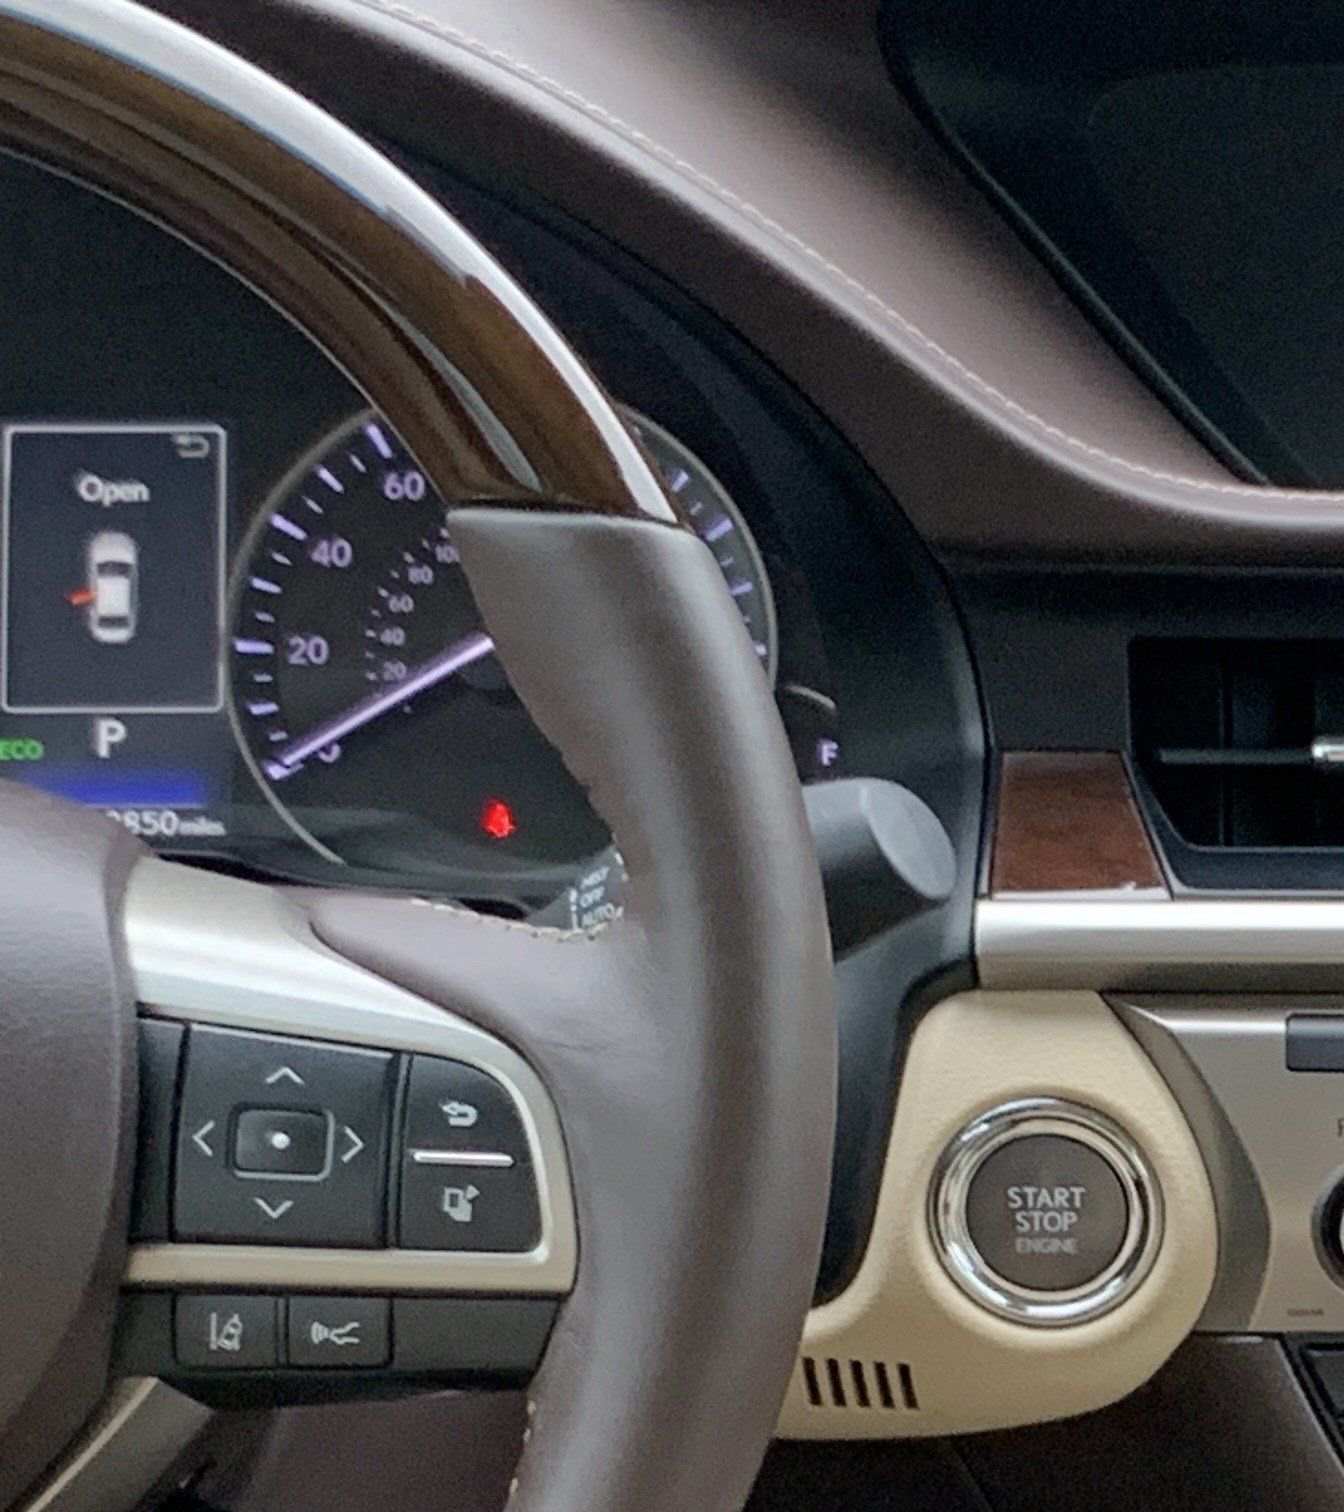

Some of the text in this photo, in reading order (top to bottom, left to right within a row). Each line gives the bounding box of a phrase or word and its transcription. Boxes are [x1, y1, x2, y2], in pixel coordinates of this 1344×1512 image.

[77, 474, 151, 507] Open
[385, 470, 426, 500] 60
[312, 538, 353, 568] 40
[287, 634, 330, 666] 20
[96, 717, 127, 758] P
[819, 738, 840, 767] F
[107, 810, 178, 837] 850
[1007, 1186, 1086, 1209] START
[1015, 1210, 1078, 1233] STOP
[1016, 1237, 1078, 1255] ENGINE
